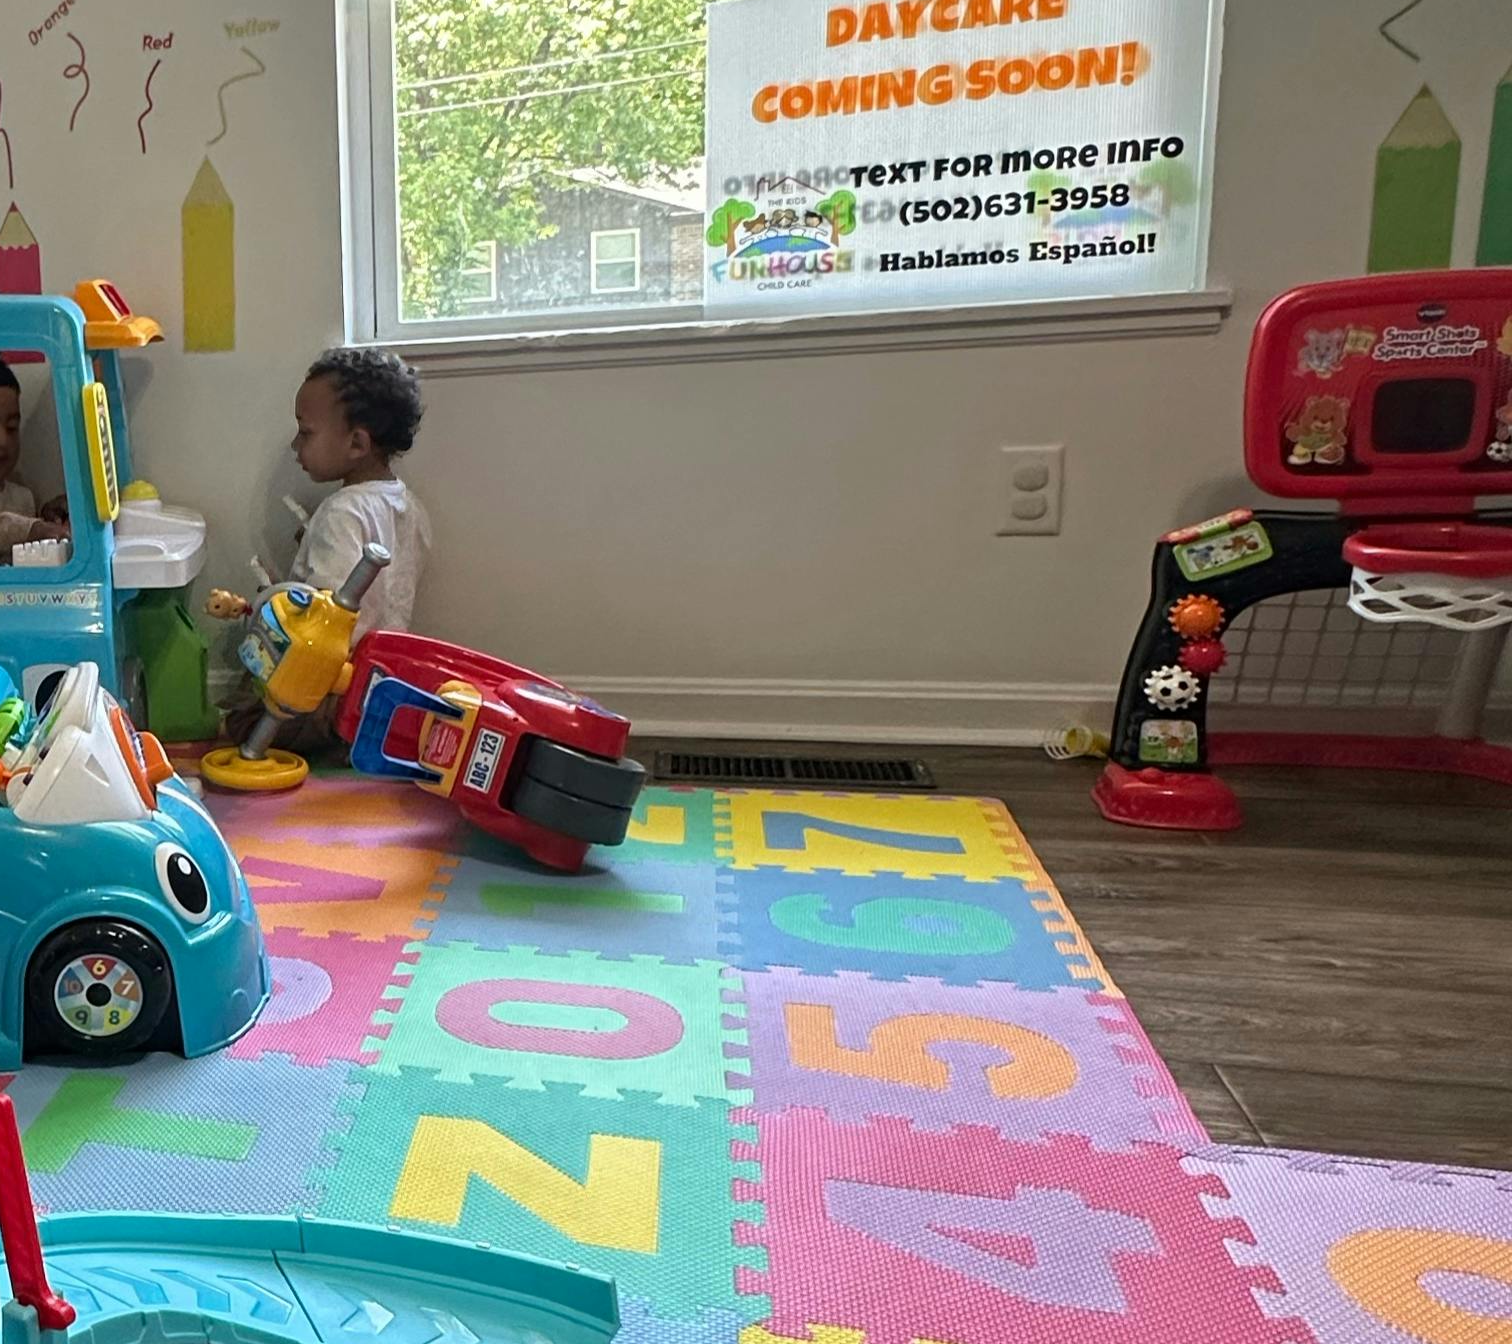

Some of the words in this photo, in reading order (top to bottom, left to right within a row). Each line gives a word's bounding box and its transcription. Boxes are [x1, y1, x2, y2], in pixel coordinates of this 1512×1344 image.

[223, 17, 281, 40] Yellow
[142, 32, 174, 51] Red
[751, 64, 954, 124] COMING
[964, 41, 1141, 101] SOON!
[933, 154, 994, 181] FOR
[899, 183, 1130, 227] (502)631-3958
[879, 246, 1020, 273] Hablamos
[1028, 232, 1157, 266] Español!
[757, 281, 785, 291] CHILD
[786, 279, 813, 289] CARE
[1386, 328, 1432, 342] Smart
[1438, 327, 1478, 340] Shots
[1376, 344, 1423, 358] Sports
[1426, 342, 1475, 356] Center
[470, 762, 489, 788] ABC
[480, 734, 499, 755] 123
[763, 810, 966, 854] 7
[92, 959, 106, 975] 6
[121, 980, 135, 996] 7
[75, 1009, 88, 1025] 9
[108, 1009, 120, 1025] 8
[784, 1002, 1078, 1100] 5
[823, 1178, 1164, 1315] 4
